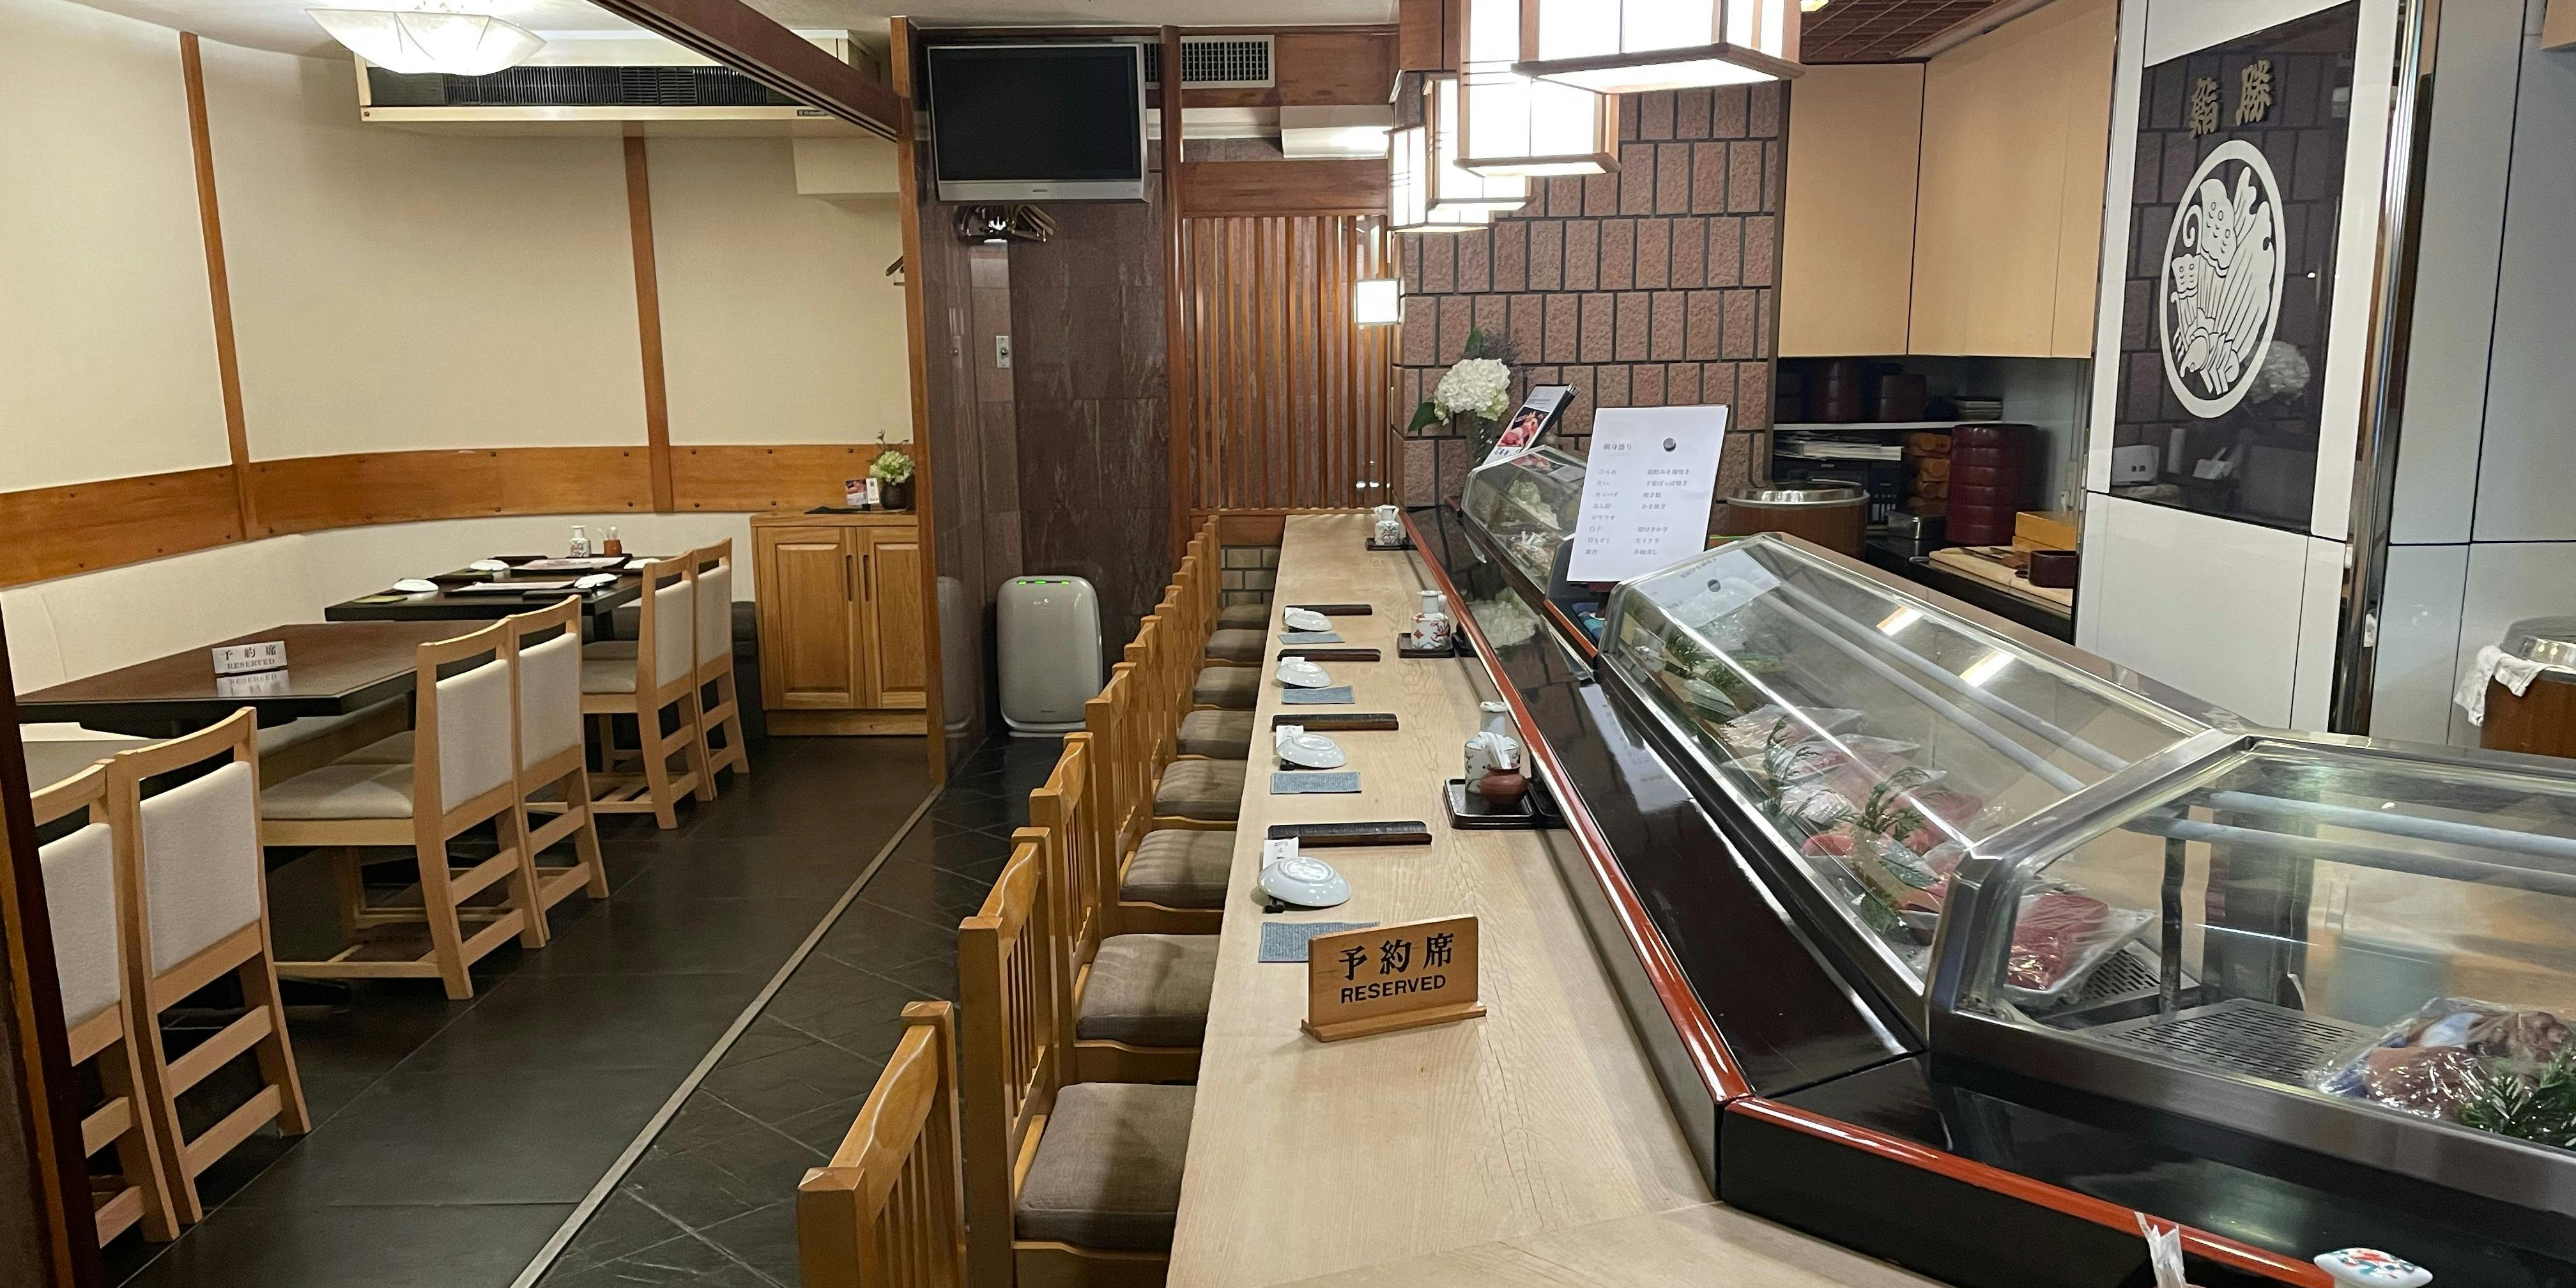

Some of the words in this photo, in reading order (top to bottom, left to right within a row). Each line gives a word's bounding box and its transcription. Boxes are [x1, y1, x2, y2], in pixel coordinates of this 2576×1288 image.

[227, 658, 275, 670] RESERVED
[1338, 932, 1454, 981] 予約席
[1341, 974, 1446, 1004] RESERVED
